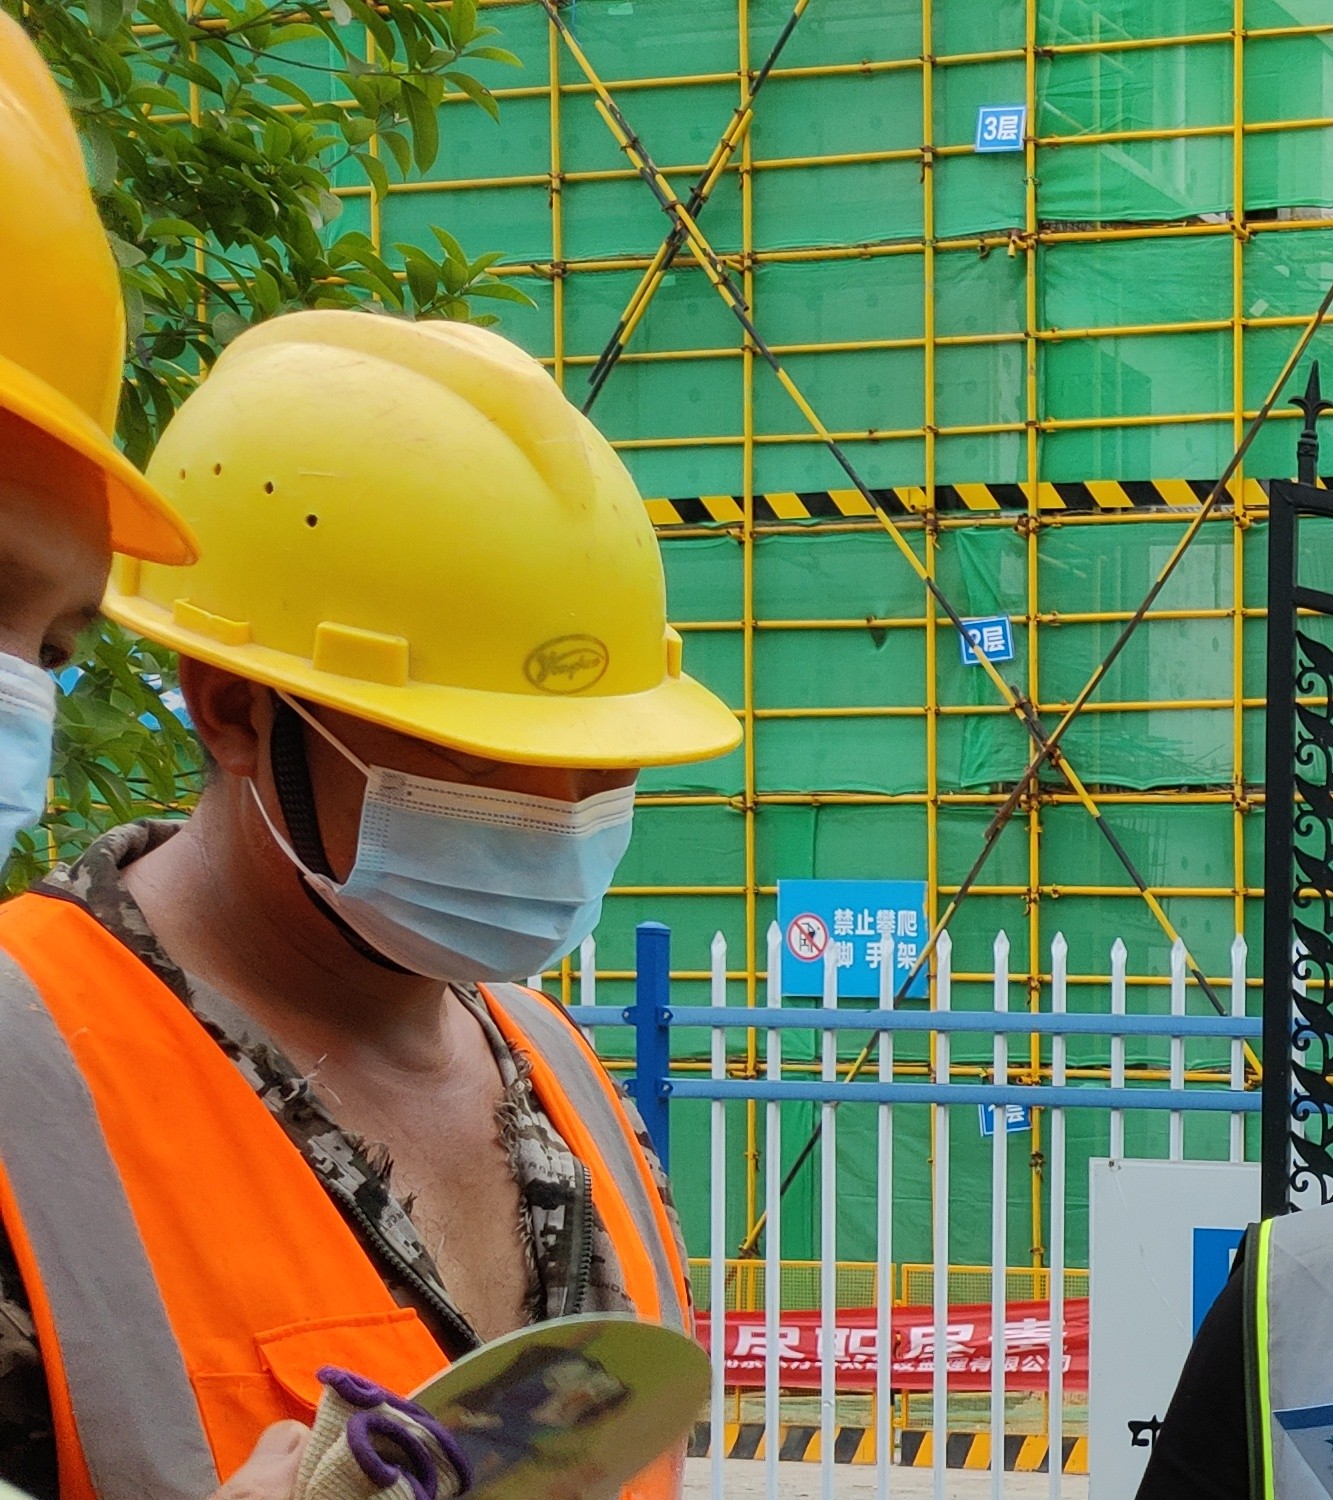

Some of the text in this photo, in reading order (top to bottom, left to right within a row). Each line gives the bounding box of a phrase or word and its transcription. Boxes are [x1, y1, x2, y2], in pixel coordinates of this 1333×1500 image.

[983, 115, 1019, 140] 3层
[833, 908, 918, 937] 禁止攀爬
